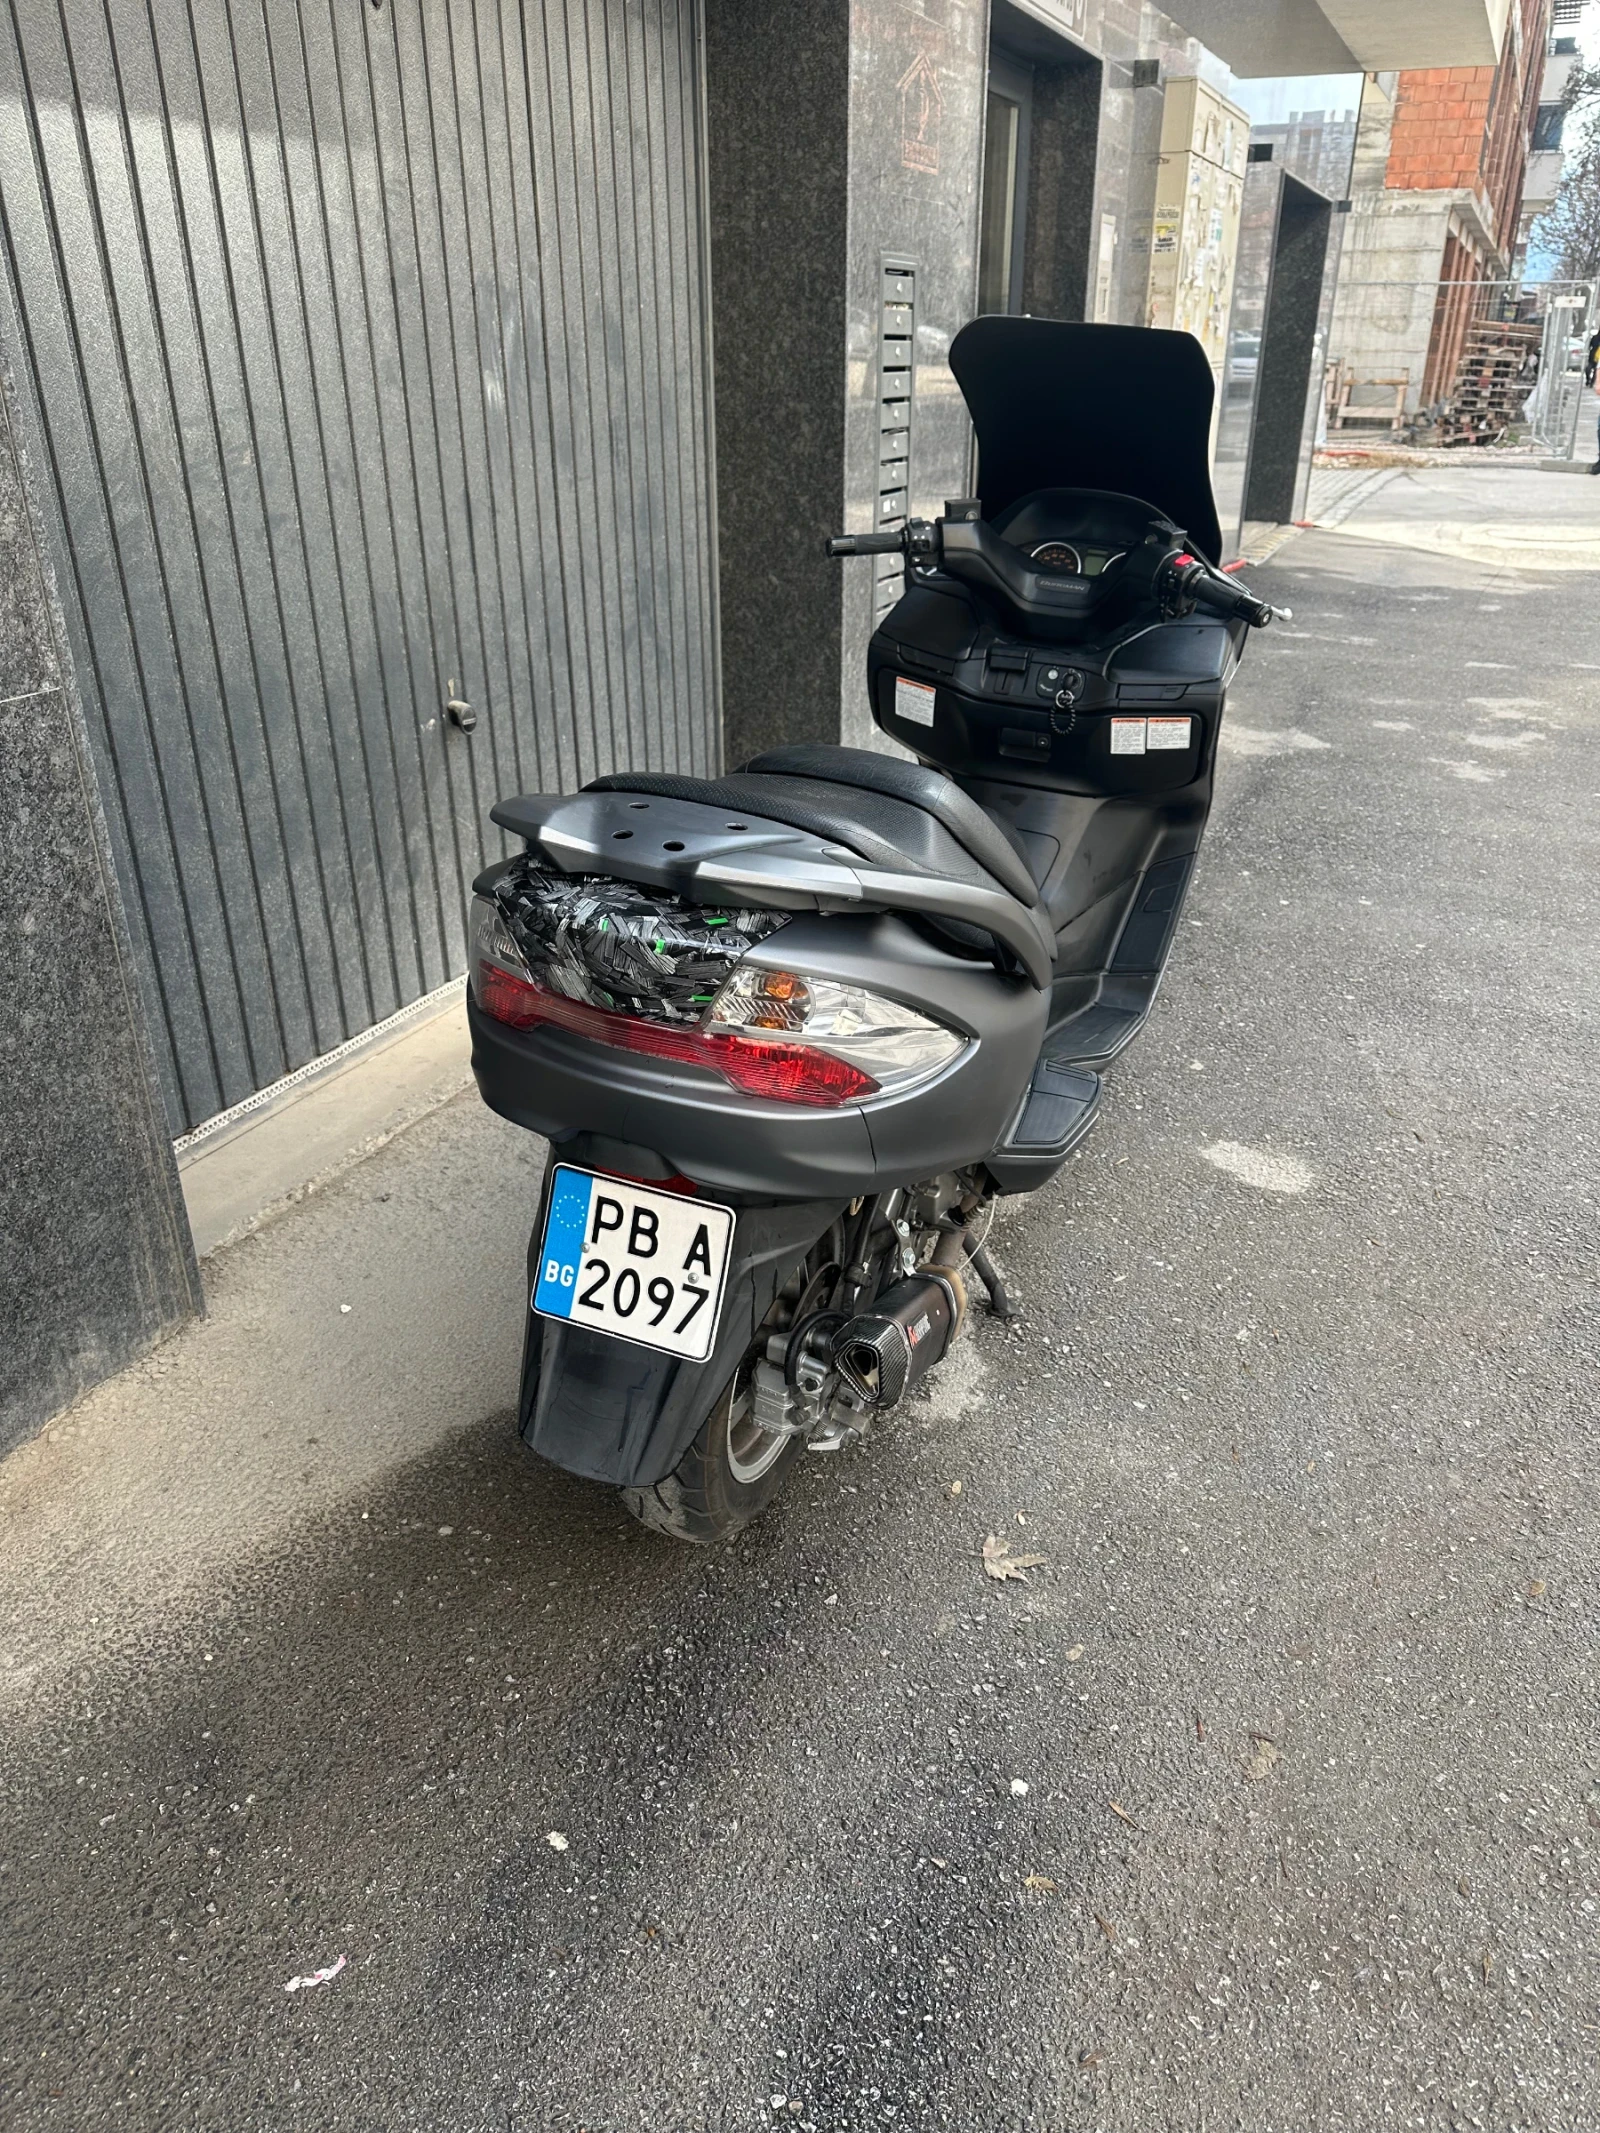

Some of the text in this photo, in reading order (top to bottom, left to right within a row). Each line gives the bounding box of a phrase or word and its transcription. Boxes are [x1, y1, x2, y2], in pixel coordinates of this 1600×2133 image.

[544, 1259, 575, 1287] BG
[591, 1195, 711, 1277] PB A
[578, 1258, 710, 1335] 2097
